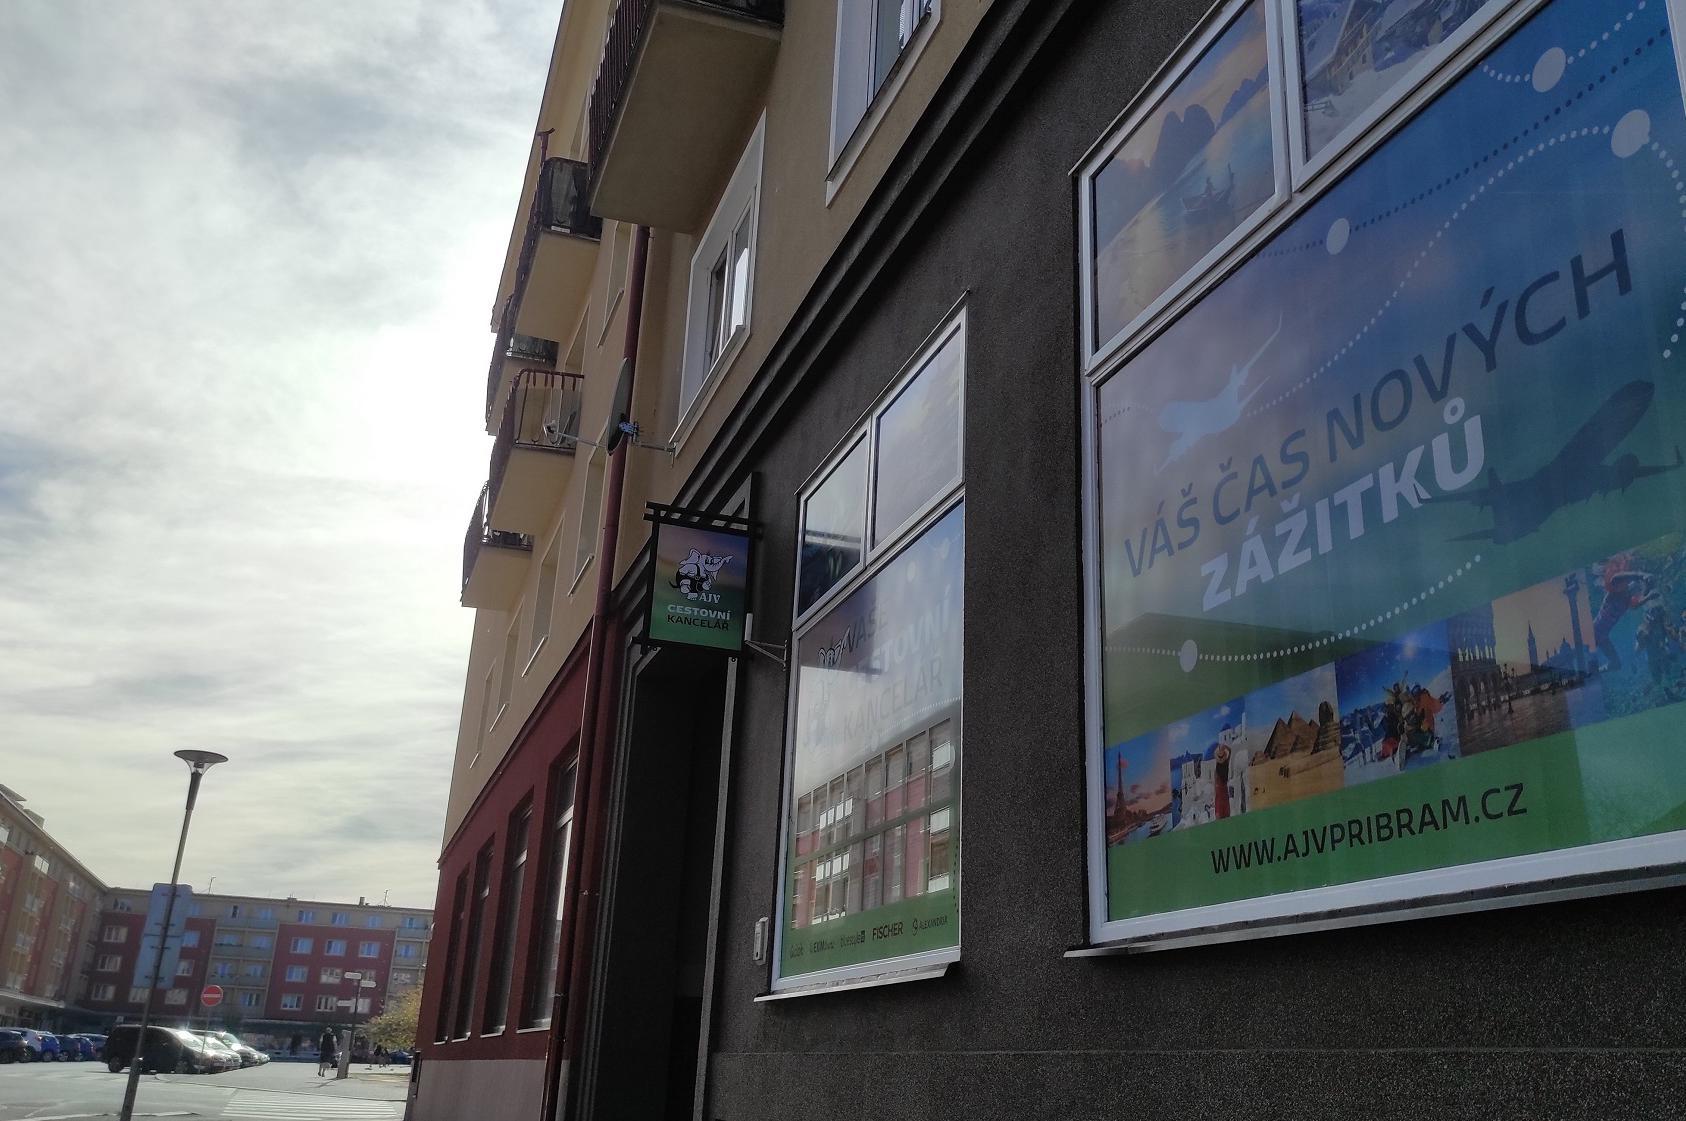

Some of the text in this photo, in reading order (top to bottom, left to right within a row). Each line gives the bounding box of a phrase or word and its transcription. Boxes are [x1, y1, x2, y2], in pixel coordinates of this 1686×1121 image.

[1123, 227, 1633, 578] VÁŠ ČAS NOVÝCH
[1201, 397, 1486, 612] ZÁŽITKŮ
[667, 604, 731, 620] CESTOVNÍ
[1210, 782, 1528, 875] WWW.AJVPRIBRAM.CZ
[872, 921, 904, 941] FISCHER
